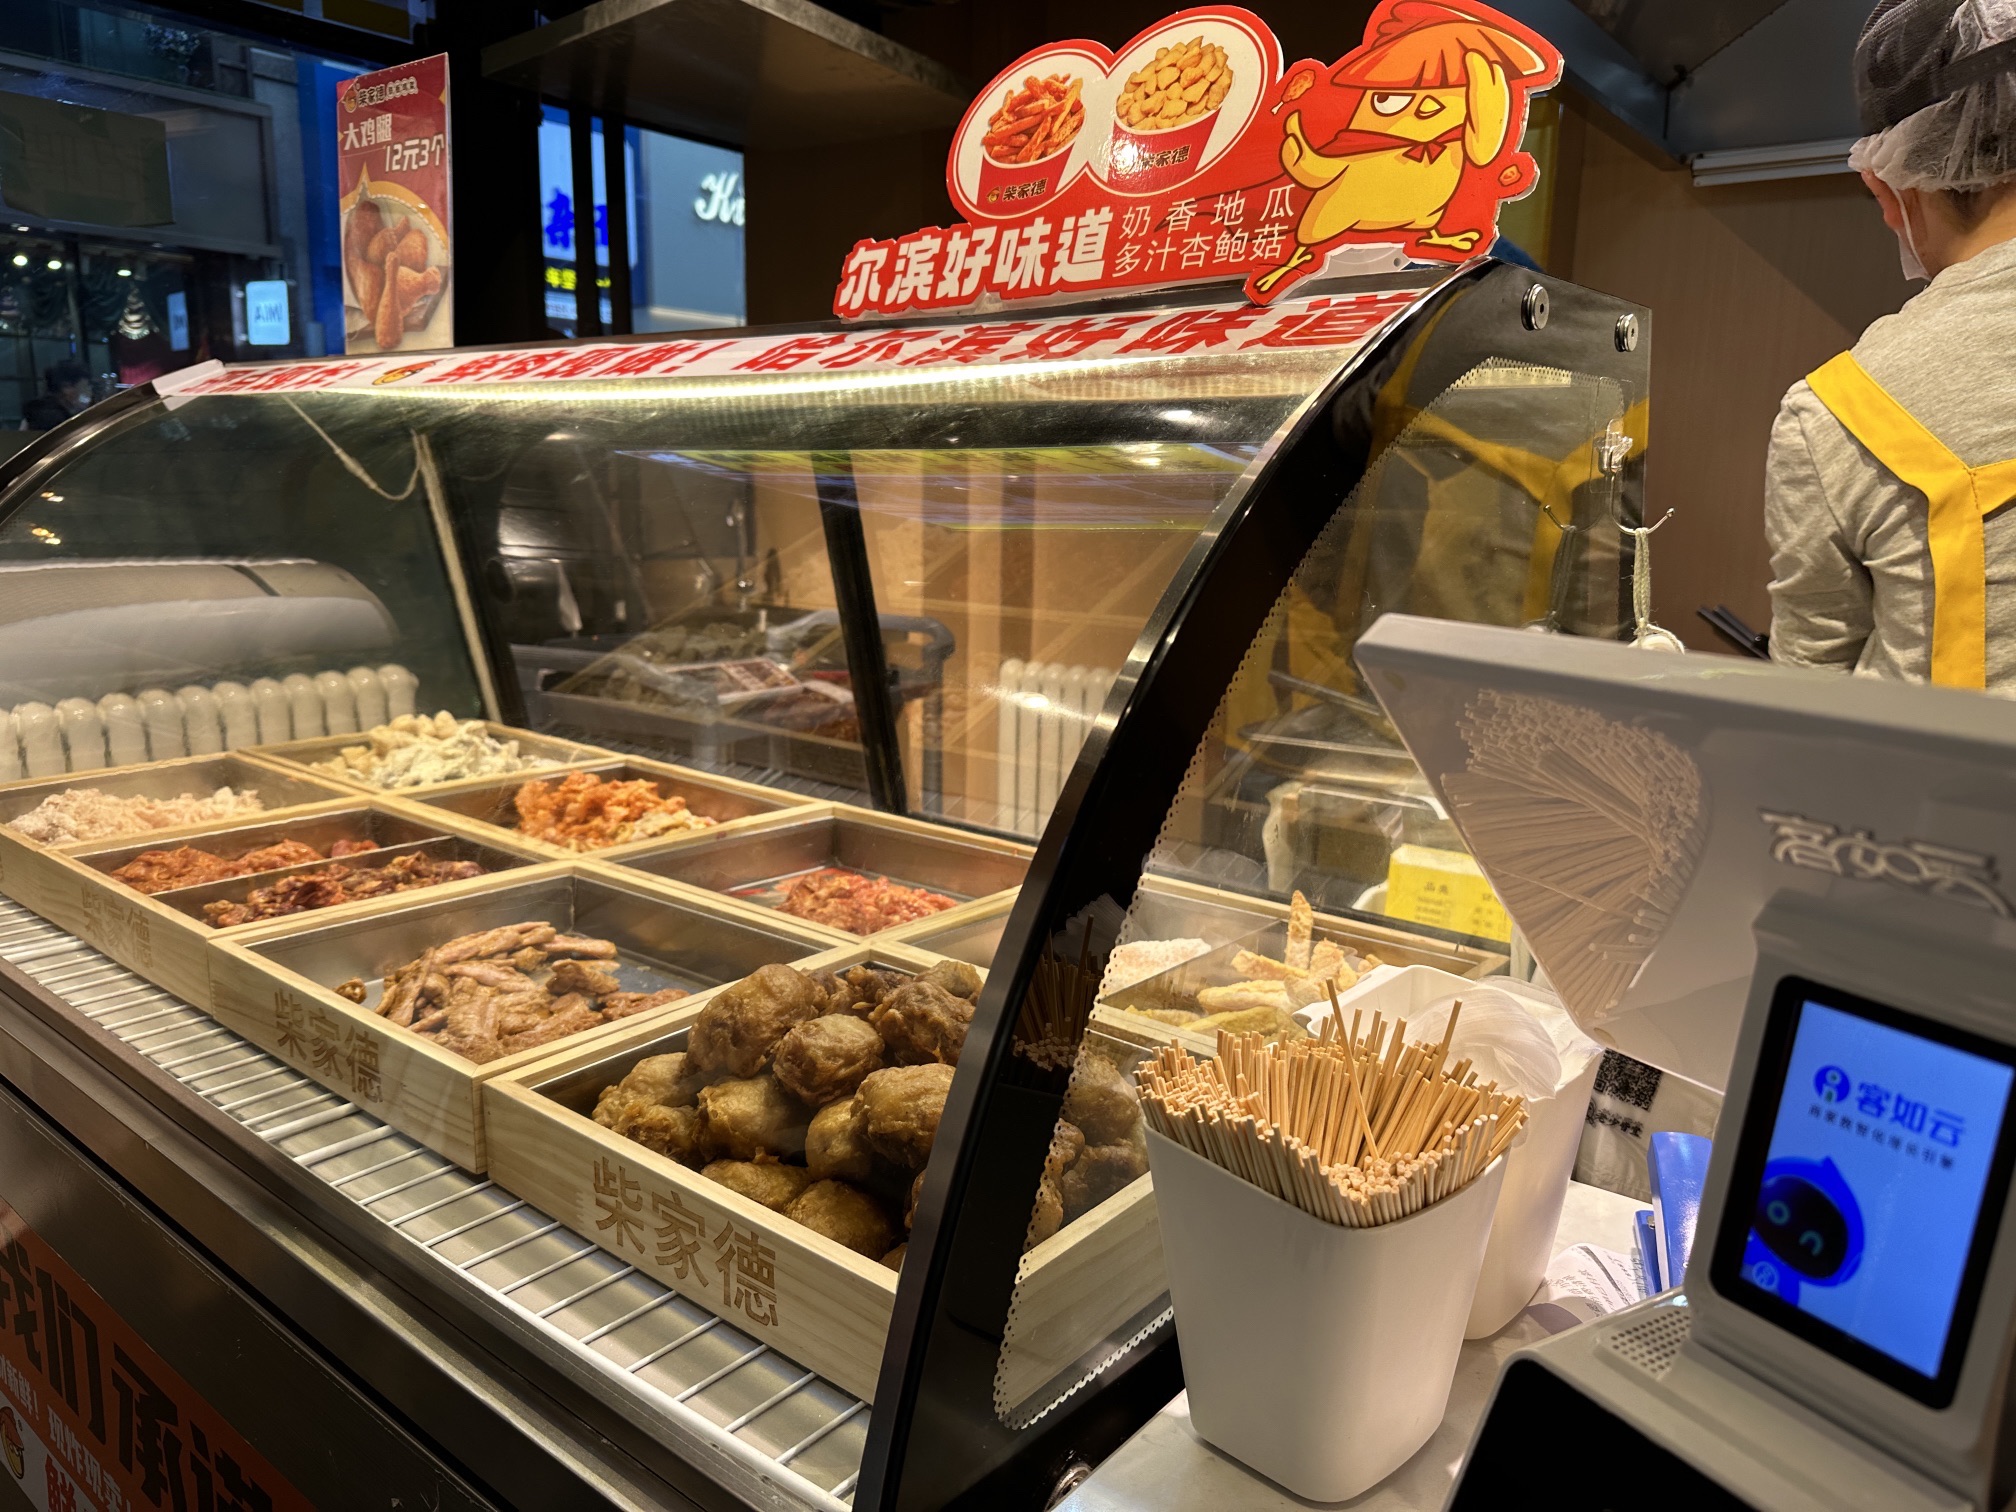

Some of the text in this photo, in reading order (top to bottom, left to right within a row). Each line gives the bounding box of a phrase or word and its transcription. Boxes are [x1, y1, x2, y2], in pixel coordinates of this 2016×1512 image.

[343, 113, 393, 151] 大鸡腿
[385, 134, 445, 172] 12元3个
[1002, 178, 1048, 201] 柴家德
[839, 206, 1113, 310] 尔滨好味道
[1112, 223, 1289, 277] 多汁杏鲍菇
[275, 988, 383, 1103] 柴家德
[1855, 1082, 1967, 1148] 客如云
[593, 1156, 779, 1327] 柴家德
